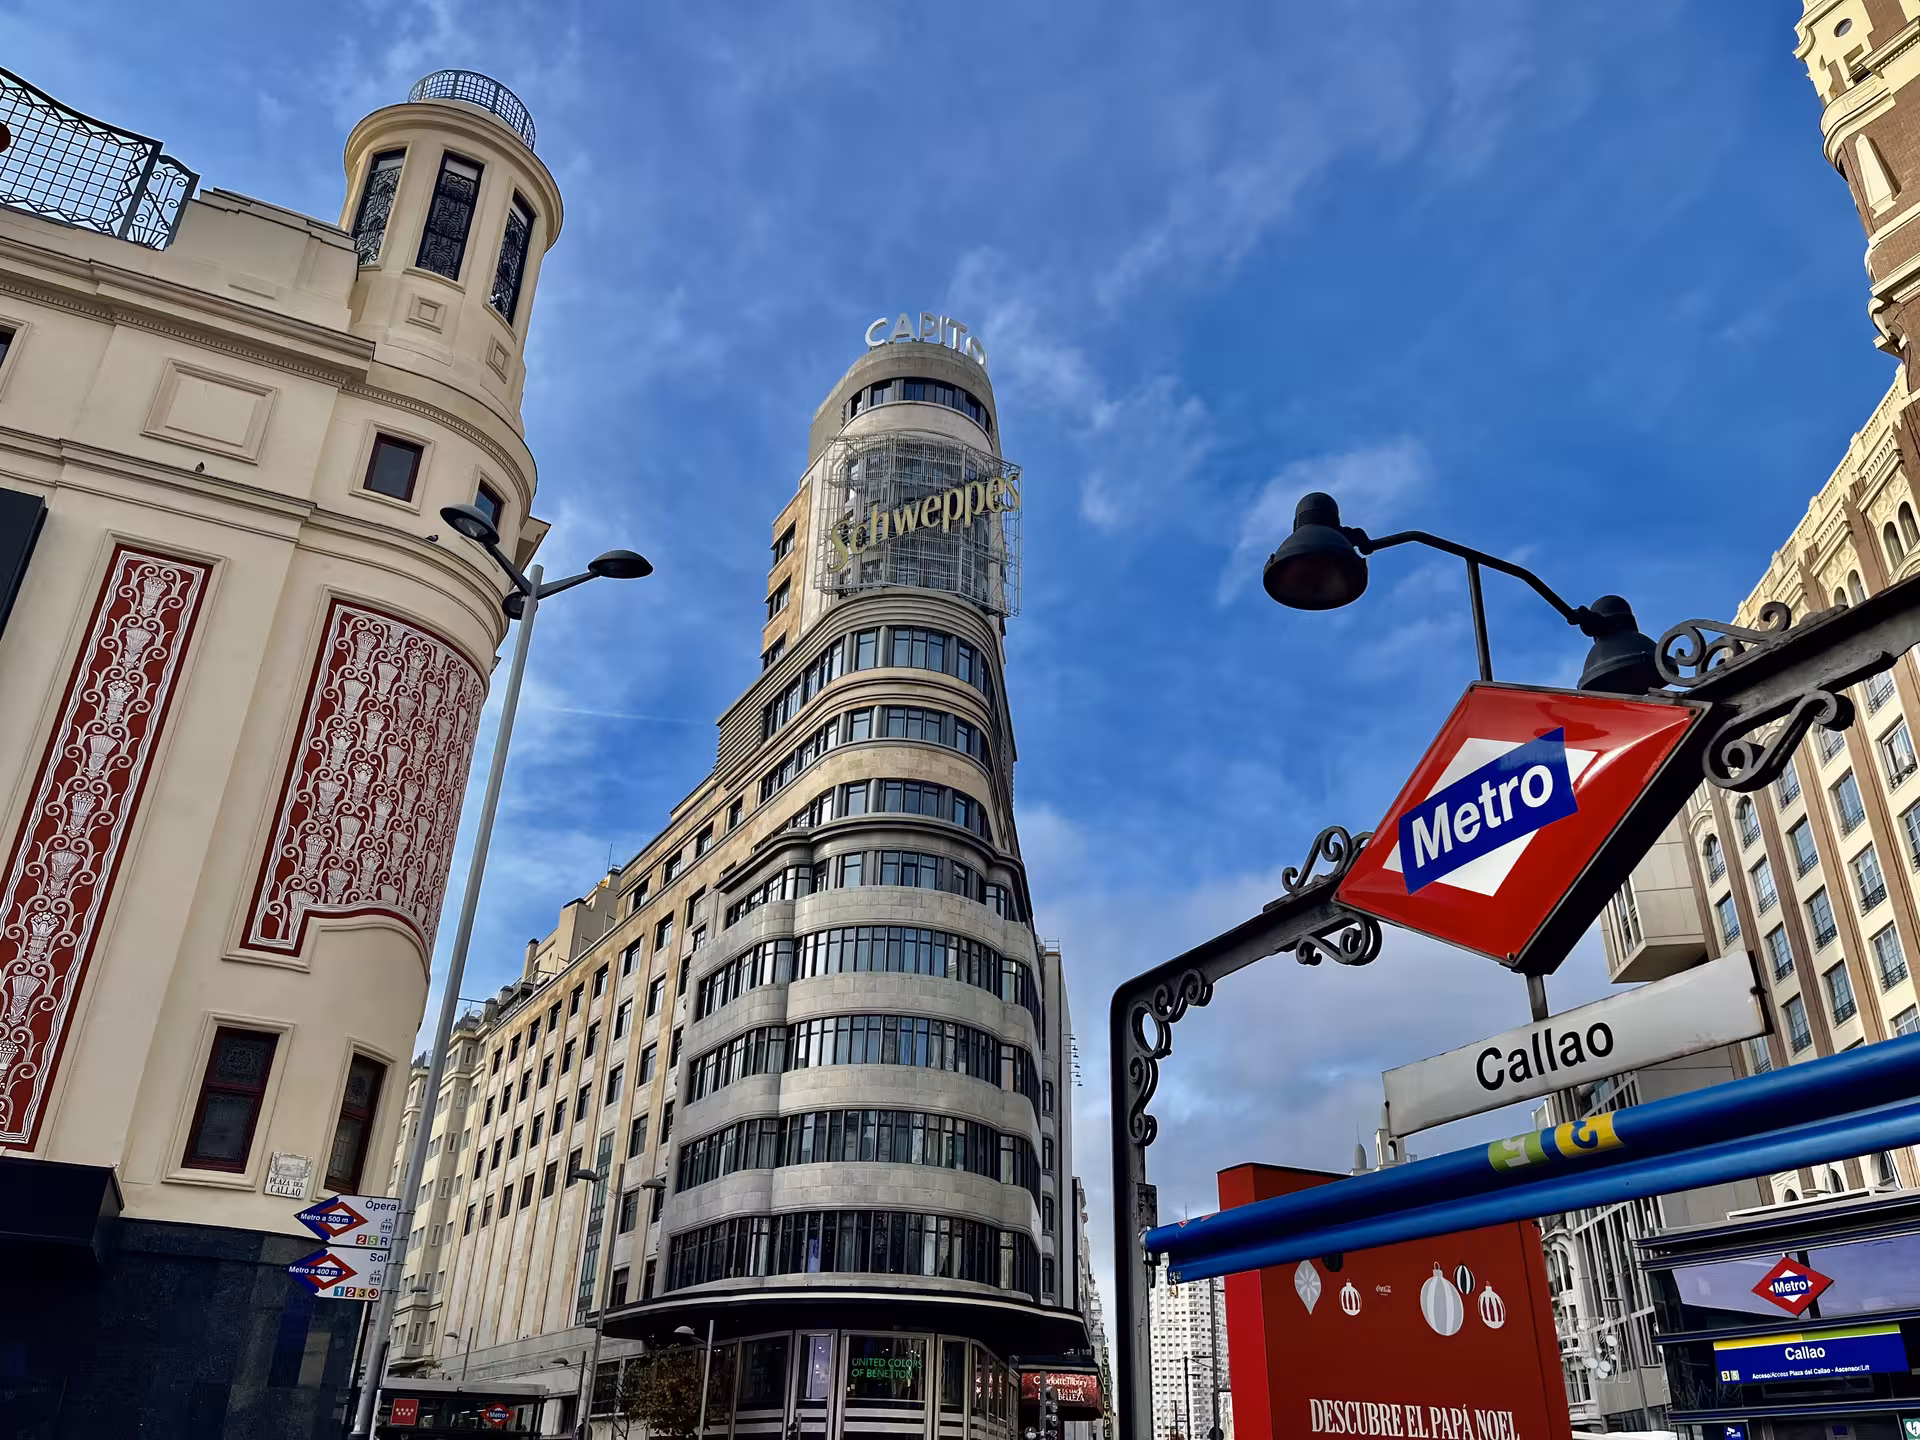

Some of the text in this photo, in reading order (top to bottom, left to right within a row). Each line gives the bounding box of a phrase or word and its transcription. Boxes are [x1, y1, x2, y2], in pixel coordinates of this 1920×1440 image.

[865, 312, 989, 369] CAPITO
[827, 473, 1020, 573] Schweppes
[1411, 764, 1554, 869] Metro
[1475, 1021, 1614, 1092] Callao
[269, 1176, 304, 1188] PLAZA DEL
[270, 1185, 301, 1197] CALLAO
[300, 1213, 320, 1221] Metro
[327, 1215, 341, 1223] 500
[357, 1234, 388, 1246] 2 5 R
[369, 1252, 388, 1262] Sol
[289, 1265, 309, 1274] Metro
[346, 1287, 355, 1297] 2
[359, 1288, 366, 1297] 3
[1774, 1280, 1807, 1294] Metro
[1784, 1345, 1826, 1361] Callao
[851, 1357, 923, 1369] UNITED COLORS
[851, 1368, 913, 1379] OF BENETTON
[1102, 1346, 1110, 1395] HOTEL
[1723, 1371, 1729, 1380] 3
[1789, 1369, 1804, 1377] Plaza
[1804, 1368, 1813, 1376] del
[1813, 1367, 1831, 1375] Callao
[489, 1411, 506, 1419] Metro
[1309, 1398, 1520, 1440] DESCUBRE EL PAPÁ NOEL
